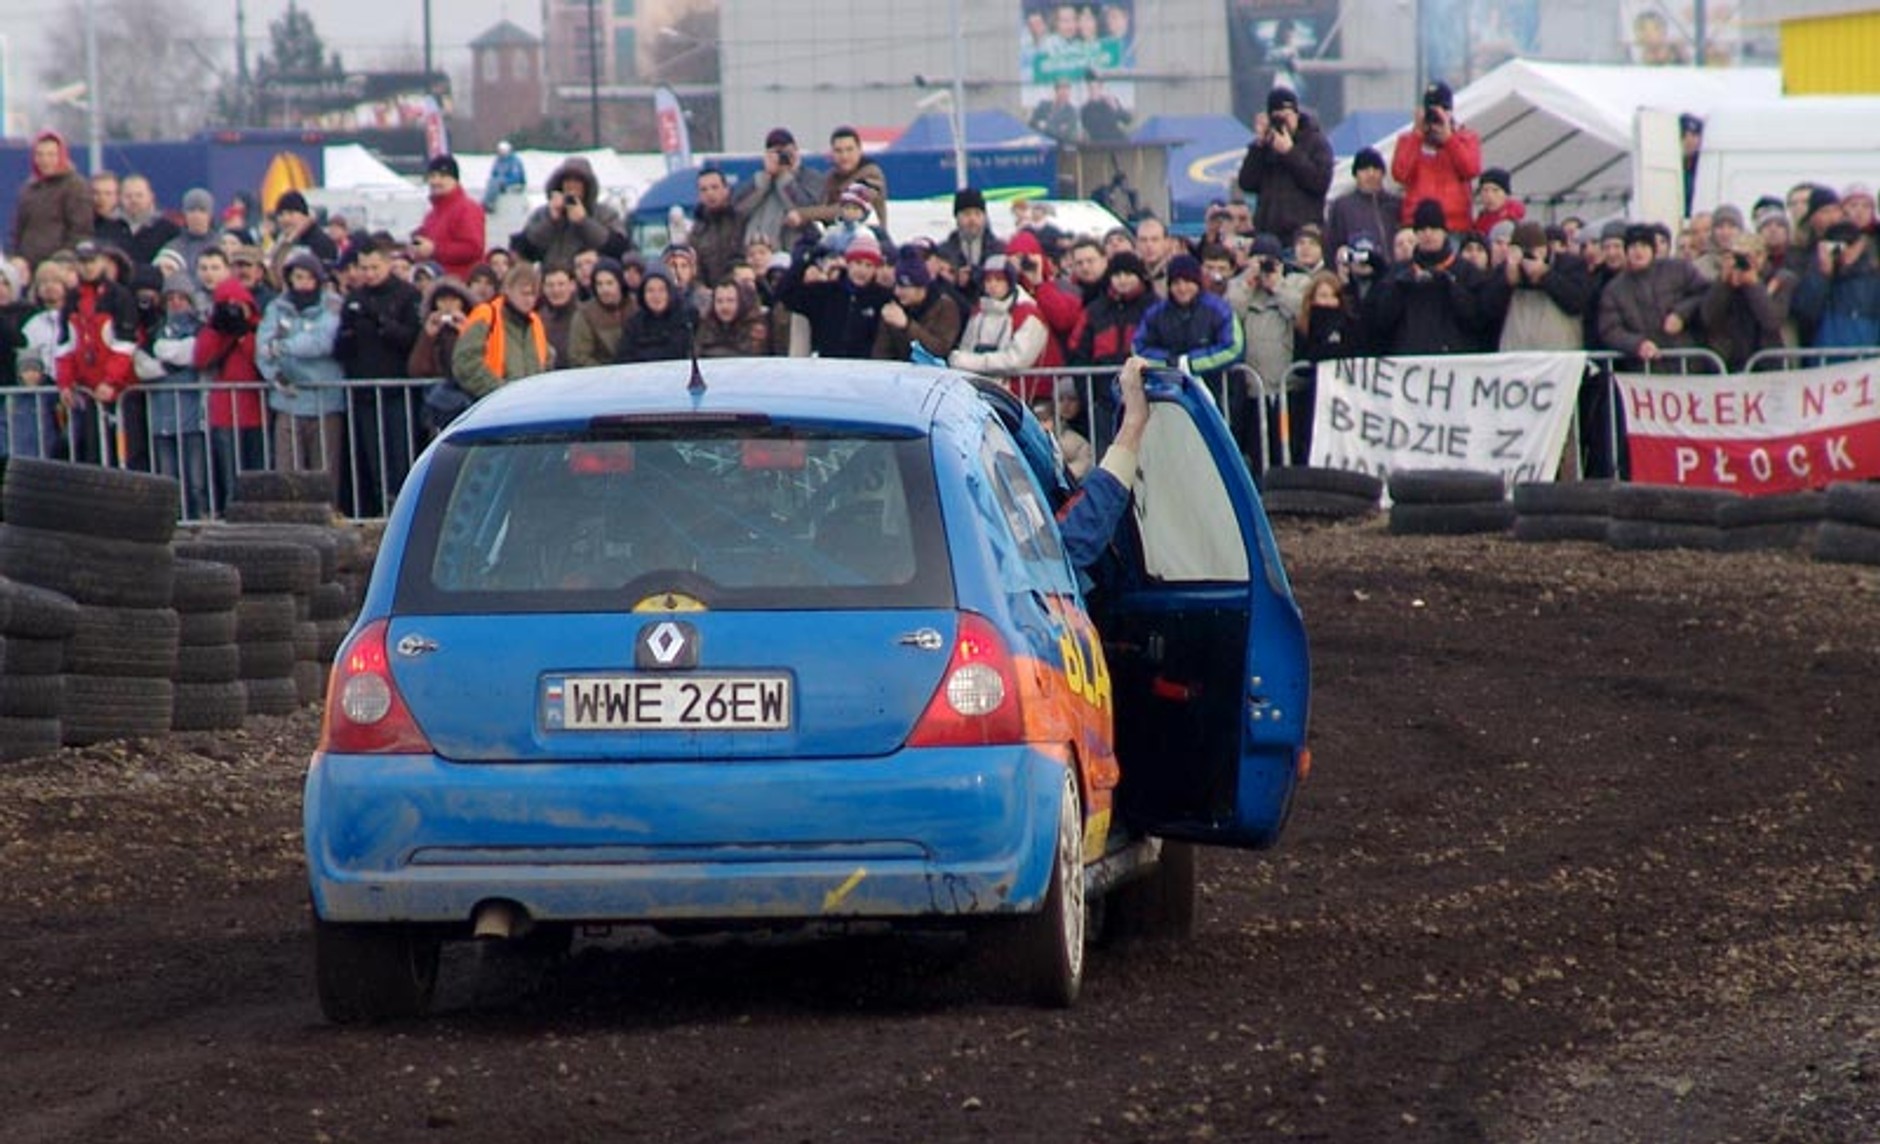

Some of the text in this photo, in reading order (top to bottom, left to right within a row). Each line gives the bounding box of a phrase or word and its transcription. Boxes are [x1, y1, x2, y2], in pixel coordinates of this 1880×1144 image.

[1334, 357, 1555, 412] NIECH MOC
[1630, 386, 1766, 425] HOŁEK
[1330, 396, 1524, 459] BĘDZIE Z
[1675, 434, 1856, 484] PŁOCK
[573, 682, 784, 723] WWE 26EW
